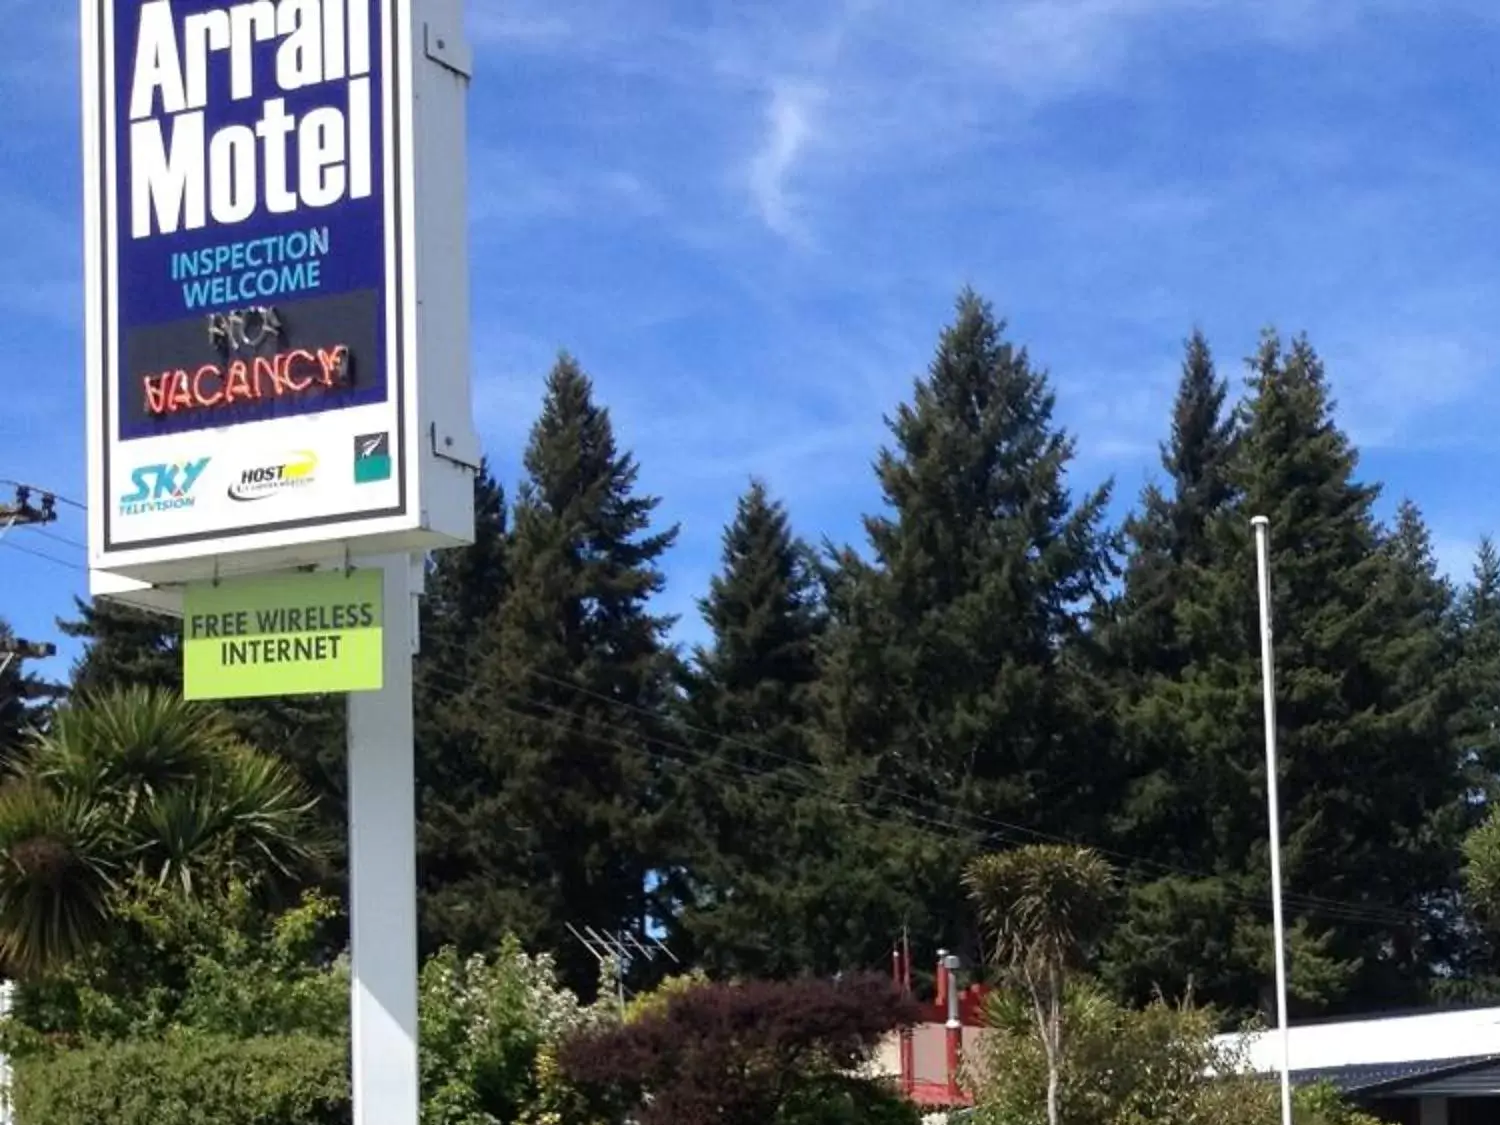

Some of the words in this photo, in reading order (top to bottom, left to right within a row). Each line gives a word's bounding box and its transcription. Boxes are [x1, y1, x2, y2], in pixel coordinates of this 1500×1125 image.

[130, 76, 372, 239] Motel
[171, 226, 330, 282] INSPECTION
[182, 260, 321, 309] WELCOME
[143, 344, 349, 414] VACANCY
[120, 456, 212, 503] SKY
[241, 463, 287, 485] HOST
[118, 497, 195, 517] TELEVISION
[191, 610, 248, 639] FREE
[257, 603, 373, 635] WIRELESS
[221, 635, 342, 666] INTERNET
